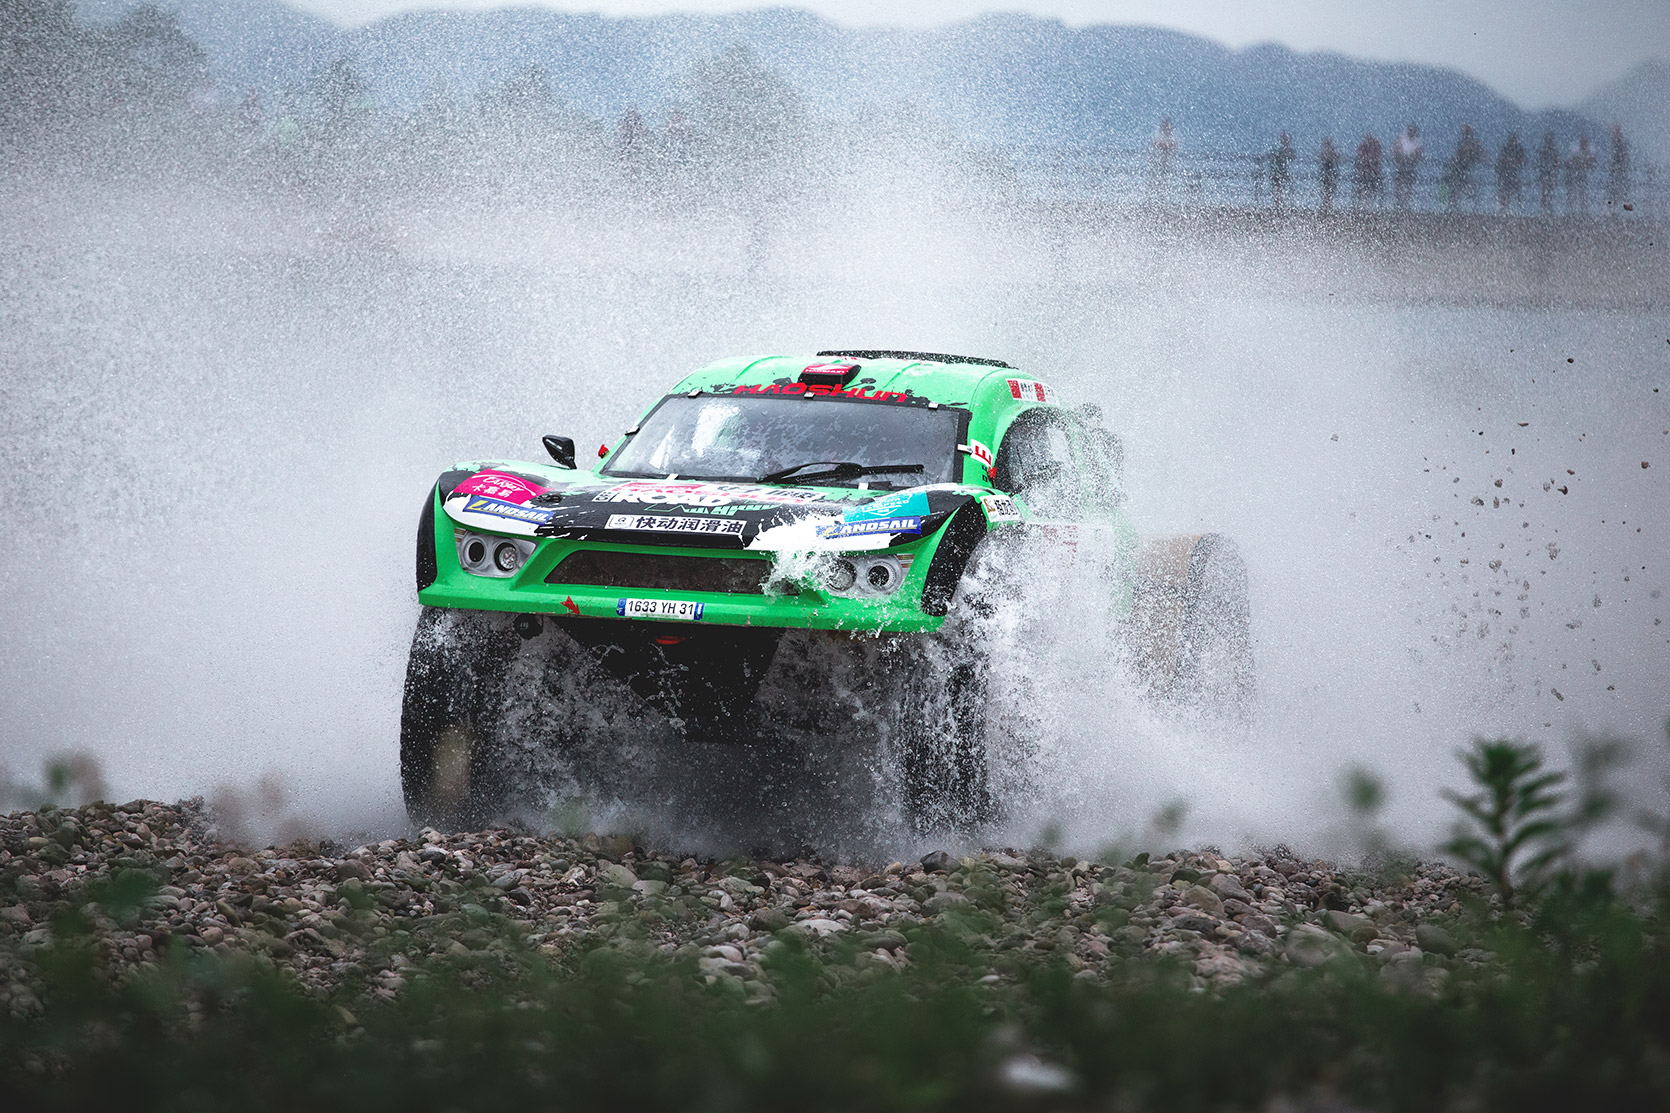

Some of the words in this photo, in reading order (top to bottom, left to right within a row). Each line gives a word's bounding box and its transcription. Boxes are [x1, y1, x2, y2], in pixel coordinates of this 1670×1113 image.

[733, 382, 907, 403] HAOSHUN
[466, 500, 549, 521] LANDSAIL
[635, 516, 746, 534] 快动润滑油
[628, 600, 657, 613] 1633
[661, 602, 676, 614] YH
[679, 603, 694, 615] 31
